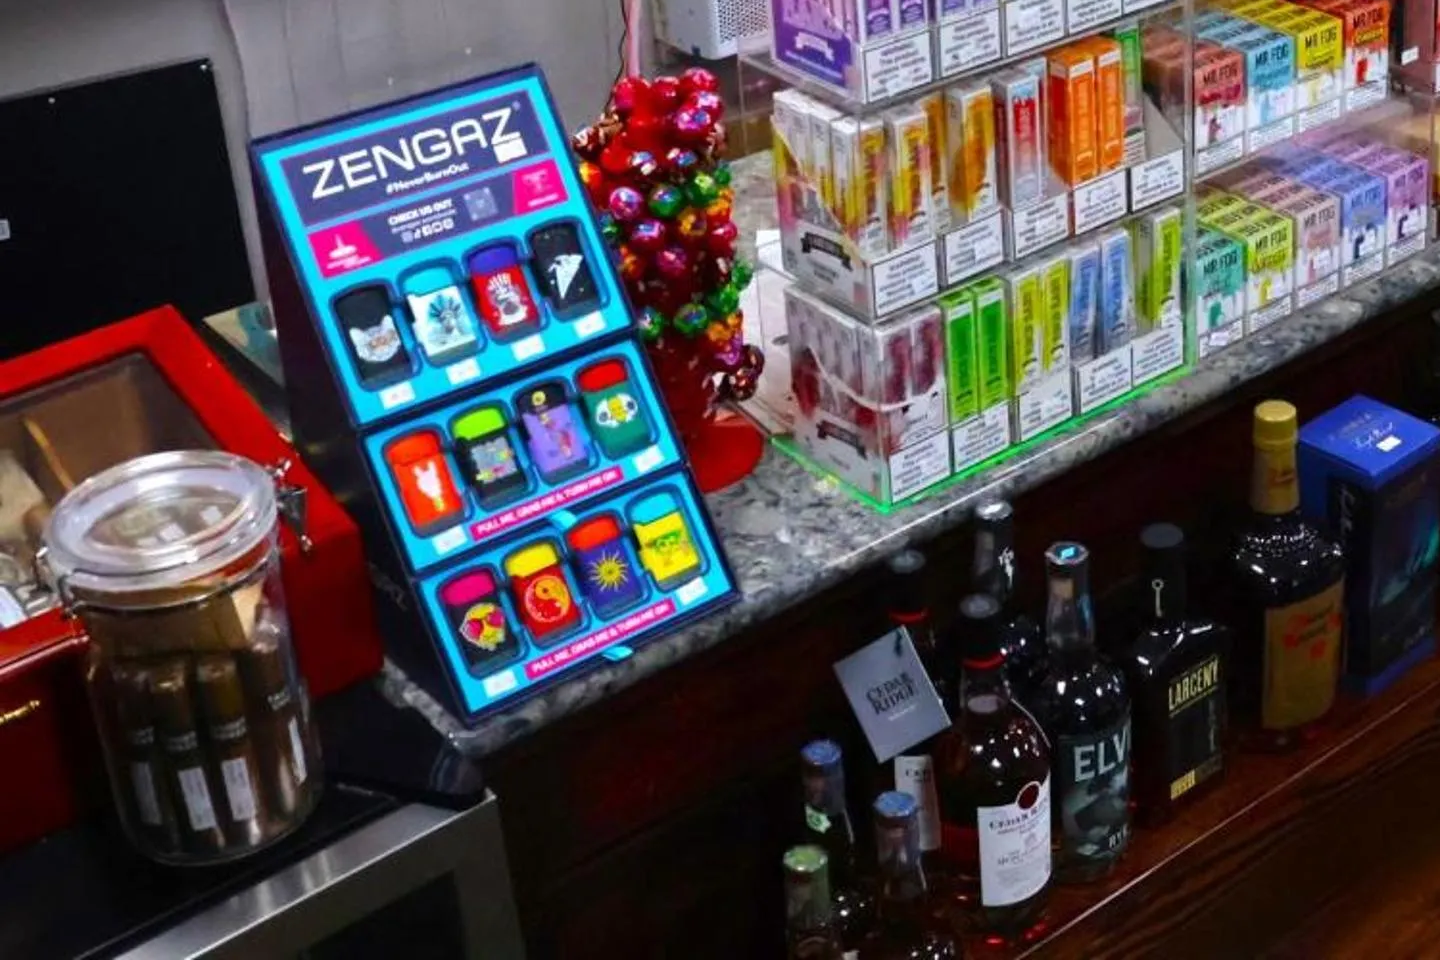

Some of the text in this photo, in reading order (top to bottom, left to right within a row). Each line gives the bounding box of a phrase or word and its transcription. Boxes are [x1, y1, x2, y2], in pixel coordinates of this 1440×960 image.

[1304, 25, 1337, 49] MR FOG
[1255, 42, 1289, 66] MR FOG
[1203, 61, 1238, 87] MR FOG
[302, 107, 521, 200] ZENGAZ
[1304, 204, 1336, 228] MR FOG
[1255, 227, 1288, 250] MR FOG
[1203, 250, 1238, 274] MR FOG
[866, 672, 914, 702] CEDAR
[1169, 658, 1219, 711] LARCENY
[871, 684, 917, 716] RIDGE
